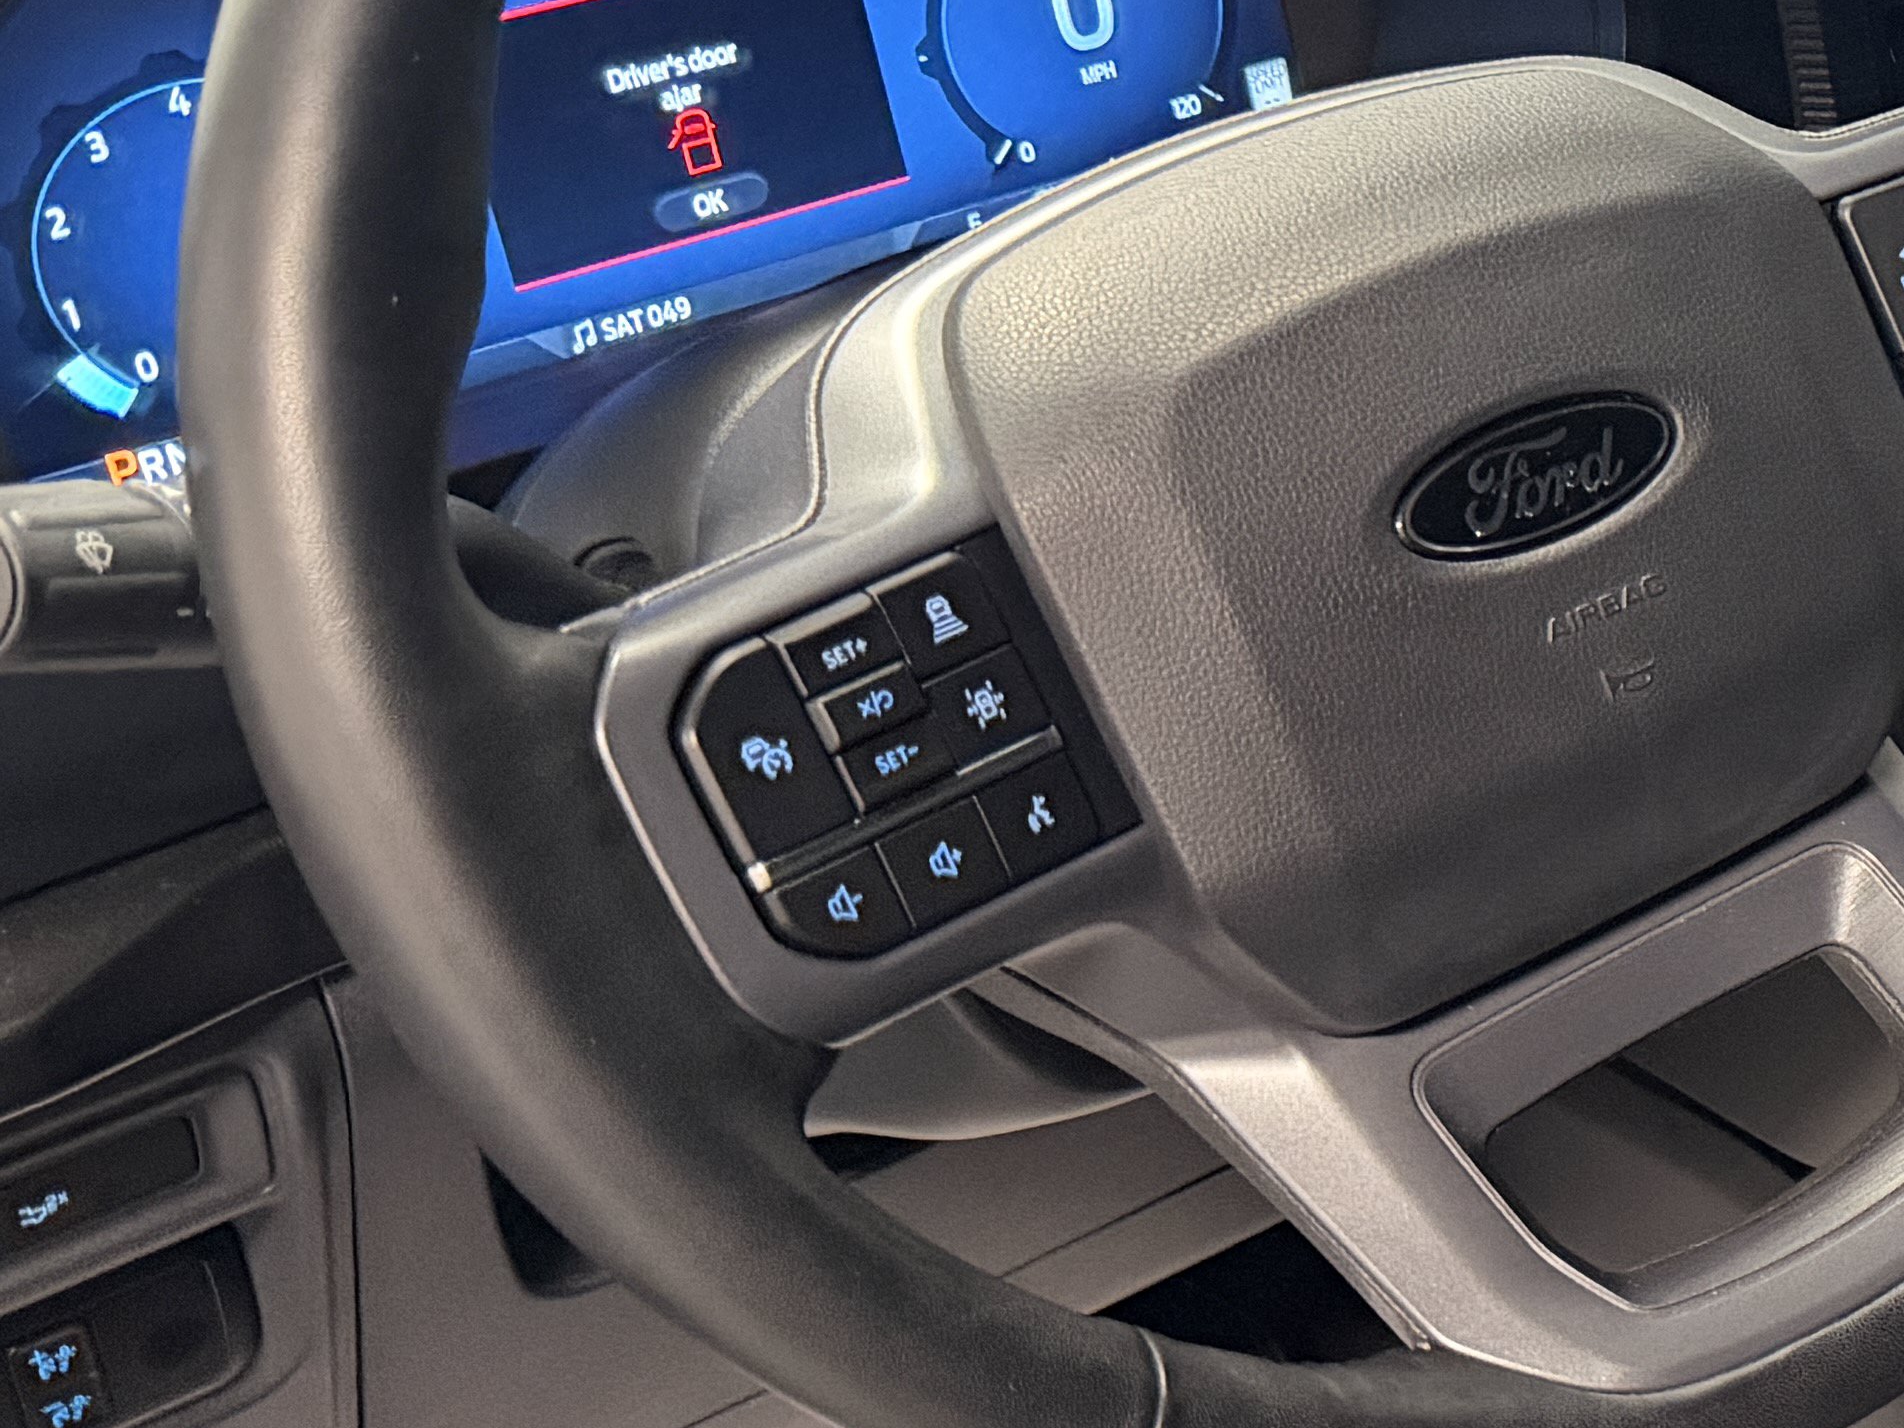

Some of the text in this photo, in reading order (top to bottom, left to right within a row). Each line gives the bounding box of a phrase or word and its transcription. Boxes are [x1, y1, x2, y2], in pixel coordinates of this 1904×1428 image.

[606, 42, 738, 95] Driver's door
[1079, 60, 1118, 85] MPH
[168, 85, 193, 117] 4
[660, 83, 702, 113] ajar
[1169, 94, 1202, 120] 120
[85, 130, 110, 164] 3
[1017, 141, 1036, 163] 0
[692, 188, 729, 220] OK
[45, 206, 71, 241] 2
[62, 298, 82, 332] 1
[600, 296, 692, 342] SAT 049
[134, 350, 160, 384] 0
[1464, 426, 1623, 538] Ford
[1547, 573, 1668, 644] AIRBAG
